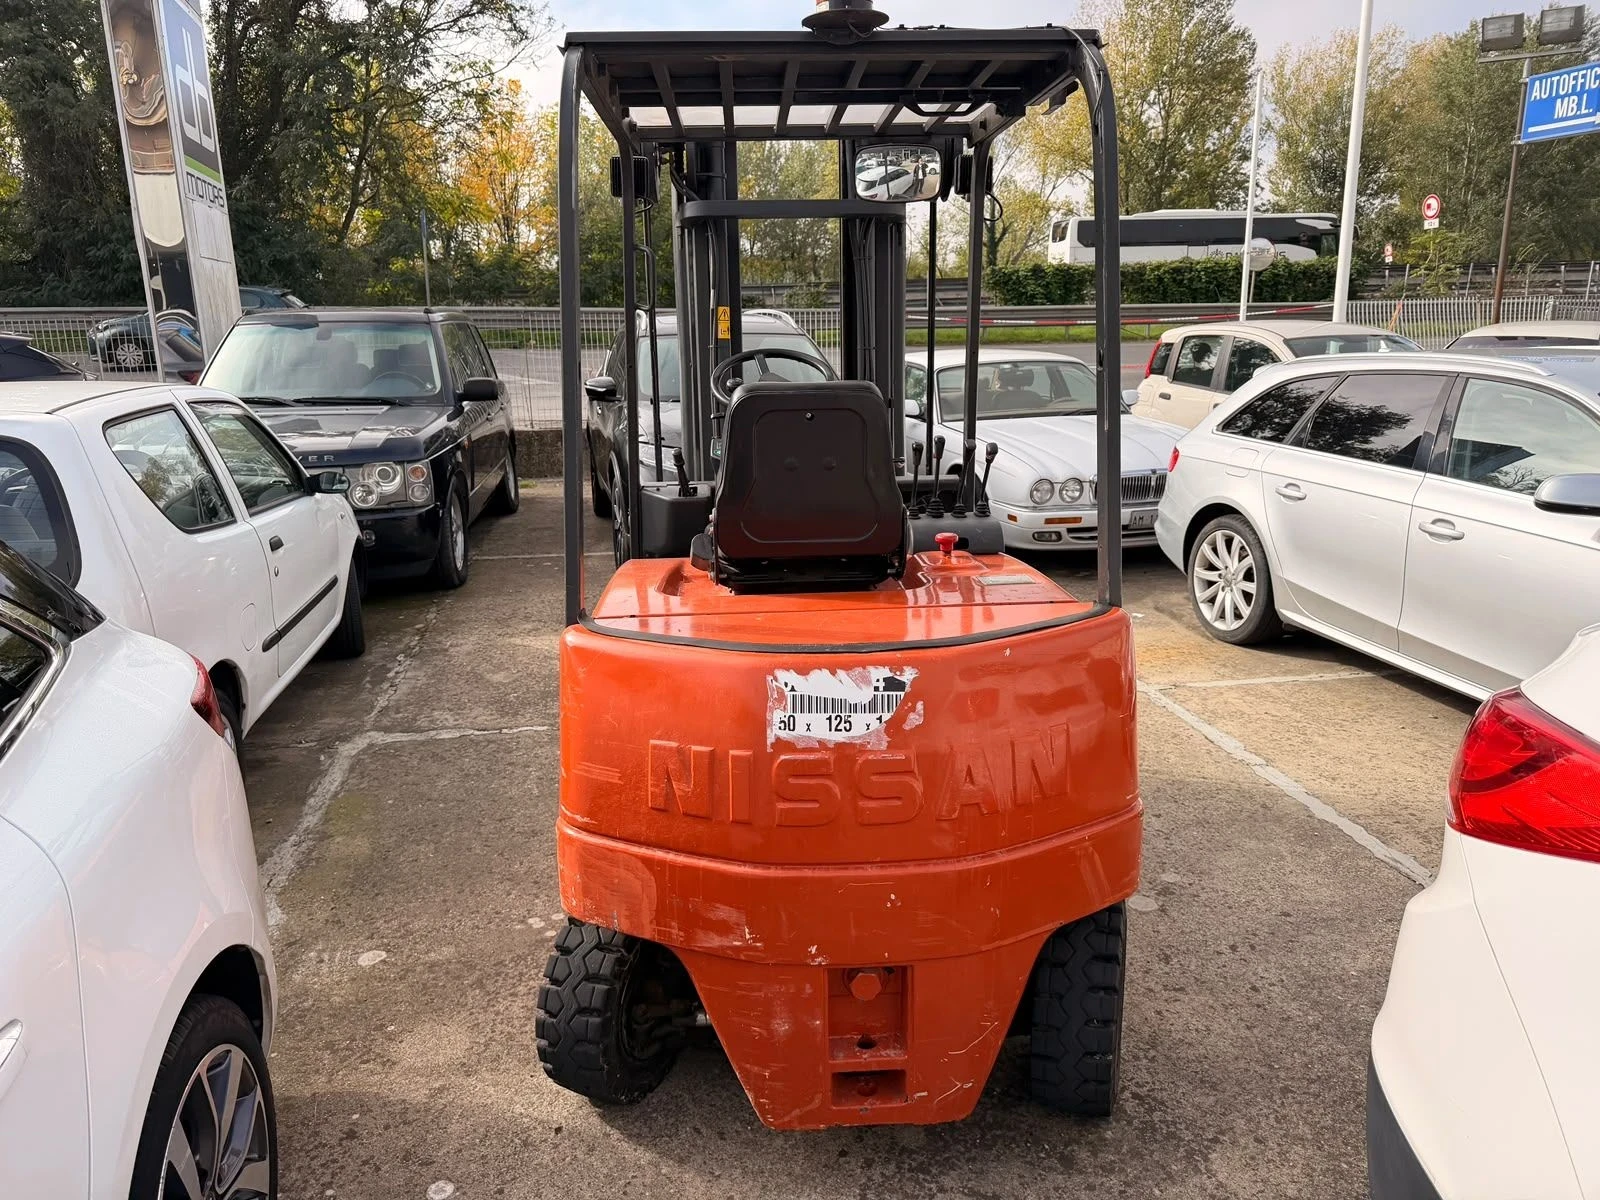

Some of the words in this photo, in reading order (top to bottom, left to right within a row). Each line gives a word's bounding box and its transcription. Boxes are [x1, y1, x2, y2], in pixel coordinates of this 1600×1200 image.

[1530, 66, 1600, 102] AUTOFFIC
[1554, 92, 1593, 120] MB.L.
[186, 171, 225, 208] MOTORS
[825, 714, 853, 732] 125
[647, 722, 1071, 828] NISSAN
